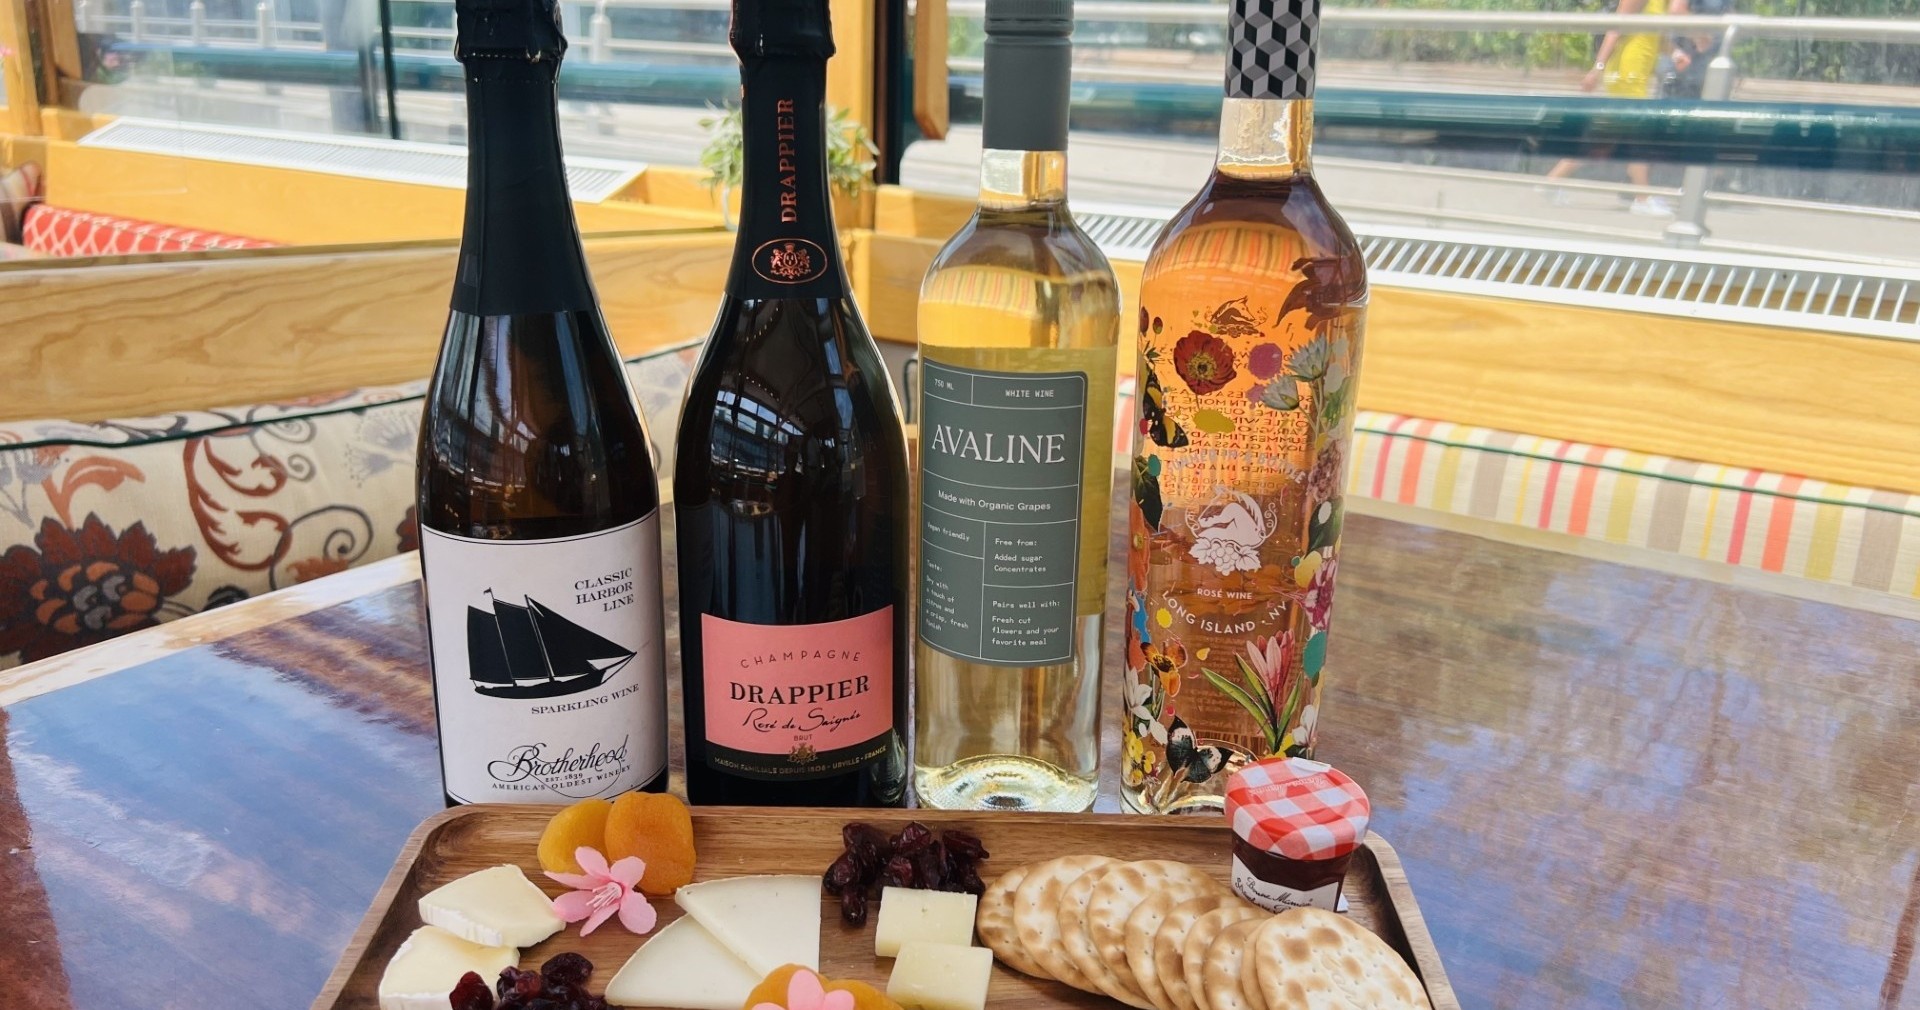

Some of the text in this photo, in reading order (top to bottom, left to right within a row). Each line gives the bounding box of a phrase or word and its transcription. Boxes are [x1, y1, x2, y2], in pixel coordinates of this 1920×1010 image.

[777, 98, 797, 223] DRAPPIER
[934, 378, 954, 391] 750 ML
[1005, 389, 1054, 398] WHITE WINE
[931, 424, 1066, 464] AVALINE
[938, 490, 1051, 512] Made with Organic Grapes
[942, 528, 970, 542] friendly
[994, 538, 1013, 546] Free
[994, 554, 1043, 563] Added sugar
[994, 565, 1046, 573] Concentrates
[574, 567, 633, 591] CLASSIC
[936, 580, 949, 590] with
[575, 581, 634, 605] HARBOR
[931, 589, 946, 600] touch
[1197, 588, 1253, 600] ROSÉ WINE
[603, 594, 634, 612] LINE
[926, 598, 955, 614] citrus and
[992, 601, 1015, 609] Pairs
[1019, 601, 1036, 609] well
[1162, 590, 1288, 635] LONG ISLAND NY
[950, 618, 969, 629] fresh
[992, 616, 1014, 624] Fresh
[992, 627, 1060, 636] flowers and your
[992, 638, 1026, 646] favorite
[740, 649, 862, 669] CHAMPAGNE
[729, 675, 871, 705] DRAPPIER
[531, 683, 640, 715] SPARKLING WINE
[742, 707, 861, 733] Rosé de Saignée
[793, 734, 812, 742] BRUT
[487, 734, 629, 783] Brotherhood
[714, 757, 739, 769] MAISON
[740, 763, 777, 774] FAMILIALE
[779, 766, 805, 774] DEPUIS
[832, 758, 860, 769] URVILLE
[864, 745, 886, 760] FRANCE
[492, 764, 631, 792] AMERICA'S OLDEST WINERY
[564, 772, 584, 782] 1839
